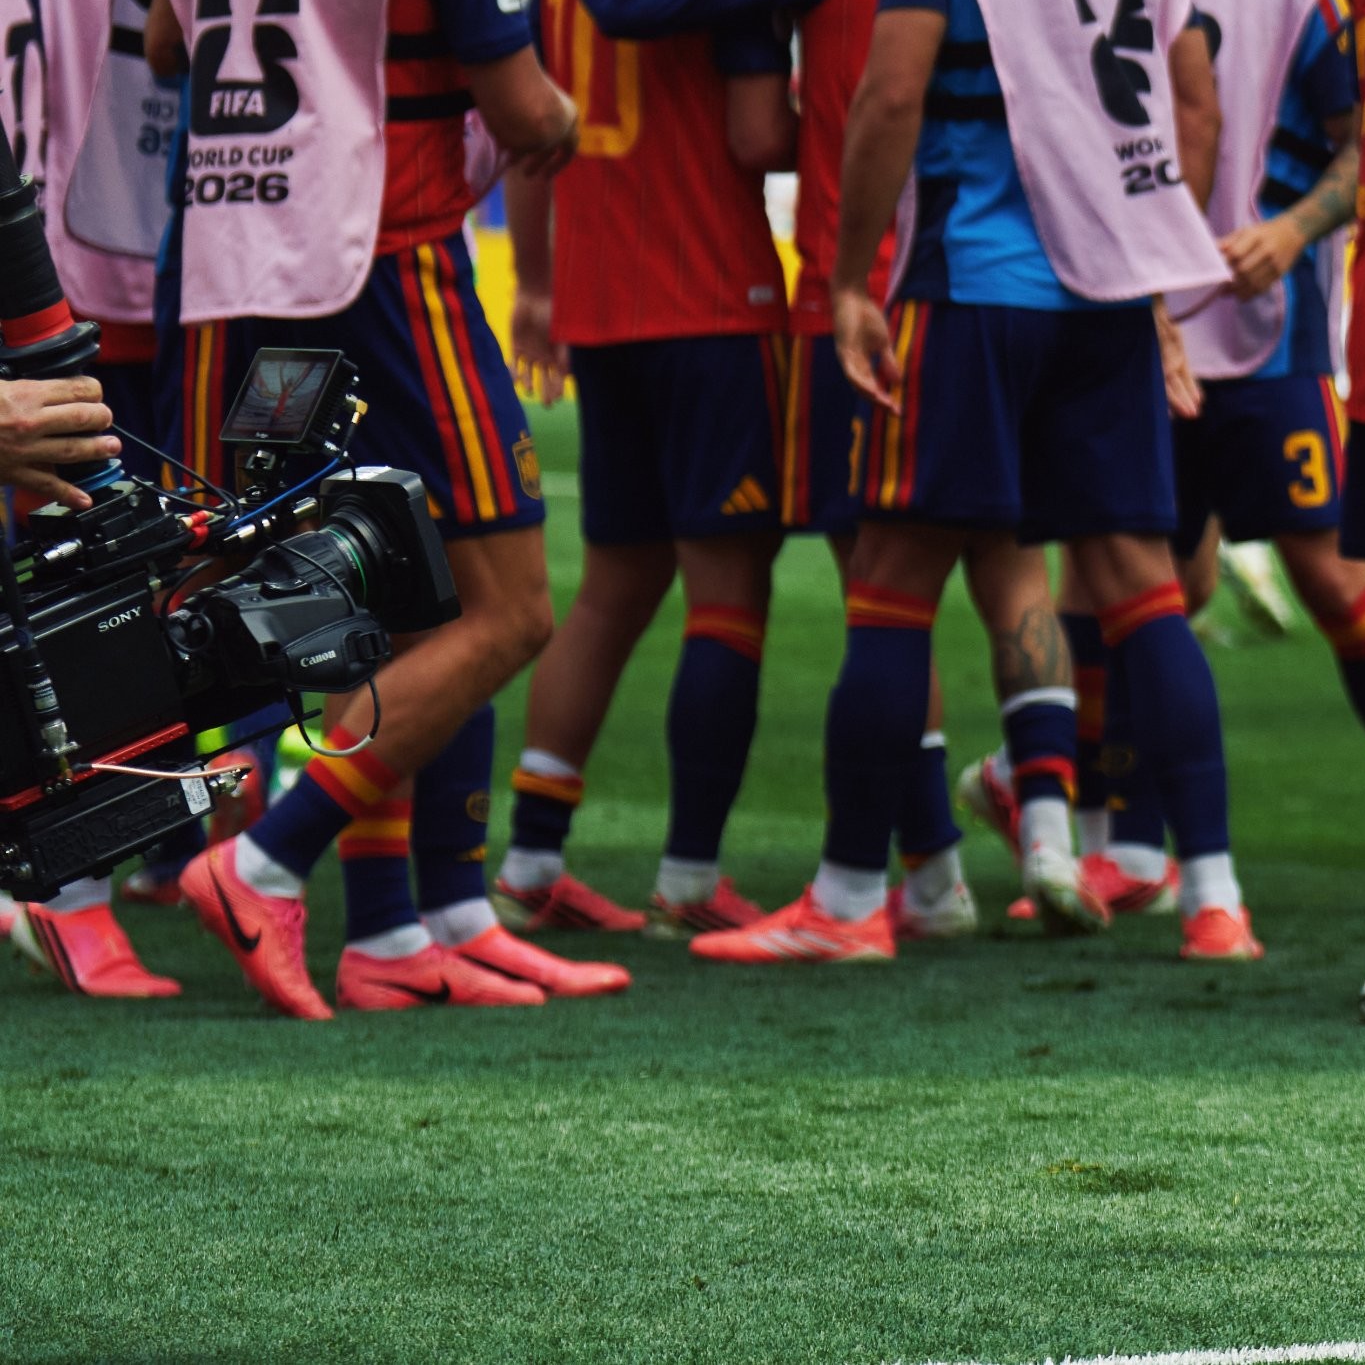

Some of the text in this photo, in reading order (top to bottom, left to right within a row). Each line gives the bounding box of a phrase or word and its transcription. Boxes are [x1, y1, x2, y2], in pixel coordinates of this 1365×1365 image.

[208, 89, 265, 119] FIFA
[187, 143, 294, 167] ORLD CUP
[1284, 431, 1331, 508] 3
[97, 605, 142, 633] SONY
[300, 648, 338, 668] Canon
